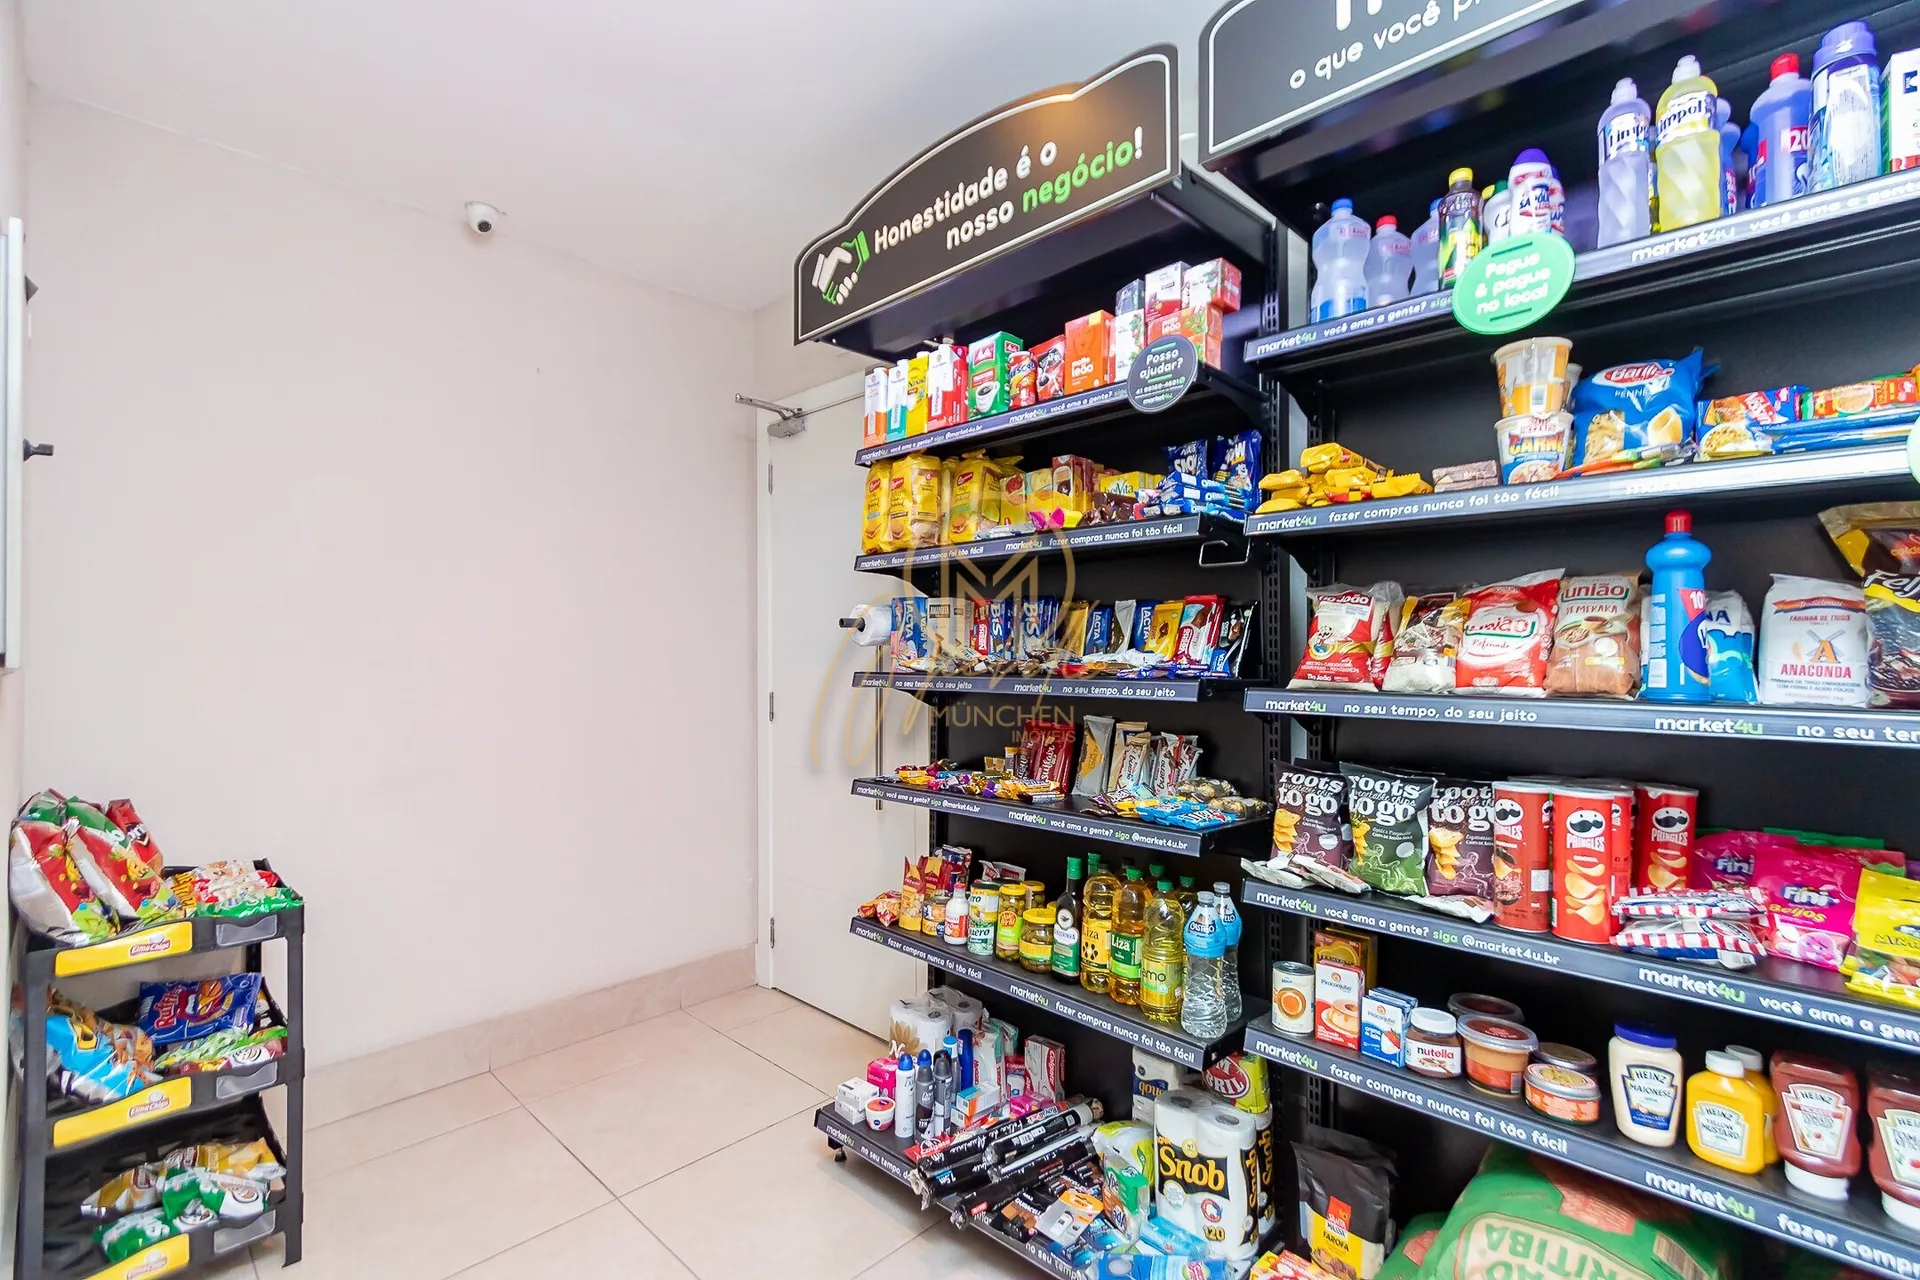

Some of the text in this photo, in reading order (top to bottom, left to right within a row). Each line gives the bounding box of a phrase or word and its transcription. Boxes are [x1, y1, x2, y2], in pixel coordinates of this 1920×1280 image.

[1289, 69, 1306, 89] o
[1315, 41, 1364, 80] que
[1373, 0, 1441, 50] você
[874, 141, 1058, 254] Honestidade é o
[946, 126, 1144, 250] nosso negócio!
[1631, 197, 1861, 262] market4u você ama a
[1485, 253, 1540, 279] Pague
[1493, 267, 1551, 296] pague
[1476, 282, 1549, 315] no local
[1257, 301, 1426, 355] market4u você ama a gente?
[1139, 357, 1184, 380] ajudar?
[1146, 349, 1179, 365] Posso
[1009, 408, 1047, 423] market4u
[1050, 403, 1065, 413] você
[1066, 400, 1081, 409] ama
[1088, 390, 1112, 404] gente?
[1143, 393, 1173, 405] market4u
[1257, 484, 1560, 532] market4u fazer compras nunca foi tão fácil
[1005, 523, 1183, 550] market4u fazer compras nunca foi tão fácil
[1564, 582, 1626, 599] união
[1093, 611, 1102, 640] LACTA
[1780, 664, 1852, 678] ANACONDA
[1013, 683, 1176, 698] market4u no seu tempo, do seu jeito
[1265, 699, 1538, 724] market4u no seu tempo, do seu jeito
[1655, 716, 1874, 741] market4u no seu
[1279, 771, 1344, 793] roots
[1348, 775, 1420, 799] roots
[856, 786, 884, 797] market4u
[913, 796, 930, 805] gente?
[942, 799, 981, 813] @market4u.br
[1278, 783, 1338, 817] to go
[1348, 790, 1416, 826] to go
[1428, 798, 1465, 824] to
[1008, 810, 1047, 826] market4u
[1050, 819, 1065, 831] você
[1066, 823, 1081, 831] ama
[1089, 827, 1113, 838] gente?
[1114, 831, 1130, 841] siga
[1132, 832, 1188, 850] @market4u.br
[1566, 833, 1605, 852] PRINGLES
[1651, 829, 1688, 847] PRINGLES
[1768, 903, 1827, 923] Beijos
[1256, 891, 1560, 965] market4u você ama a gente? siga @market4u.br
[855, 926, 982, 980] market4u fazer compras nunca foi tão fácil
[1111, 934, 1131, 952] Liza
[1639, 967, 1874, 1032] market4u você ama a
[1010, 984, 1195, 1063] market4u fazer compras nunca foi tão fácil
[1417, 1045, 1454, 1059] nutella
[1206, 1070, 1244, 1094] BRIL
[1635, 1069, 1667, 1084] HEINZ
[1255, 1040, 1567, 1154] market4u fazer compras nunca foi tão fácil
[1629, 1083, 1672, 1098] MAIONESE
[1800, 1091, 1833, 1104] HEINZ
[1706, 1106, 1735, 1121] HEINZ
[1701, 1123, 1740, 1141] MUSTARD
[826, 1124, 902, 1177] market4u no seu tempo,
[1258, 1130, 1272, 1185] Snob
[1159, 1145, 1225, 1191] Snob
[1245, 1150, 1257, 1207] Snob
[1645, 1170, 1838, 1247] market4u fazer
[1202, 1224, 1226, 1241] 120
[1322, 1231, 1350, 1252] FAROFA
[1025, 1243, 1052, 1263] no seu
